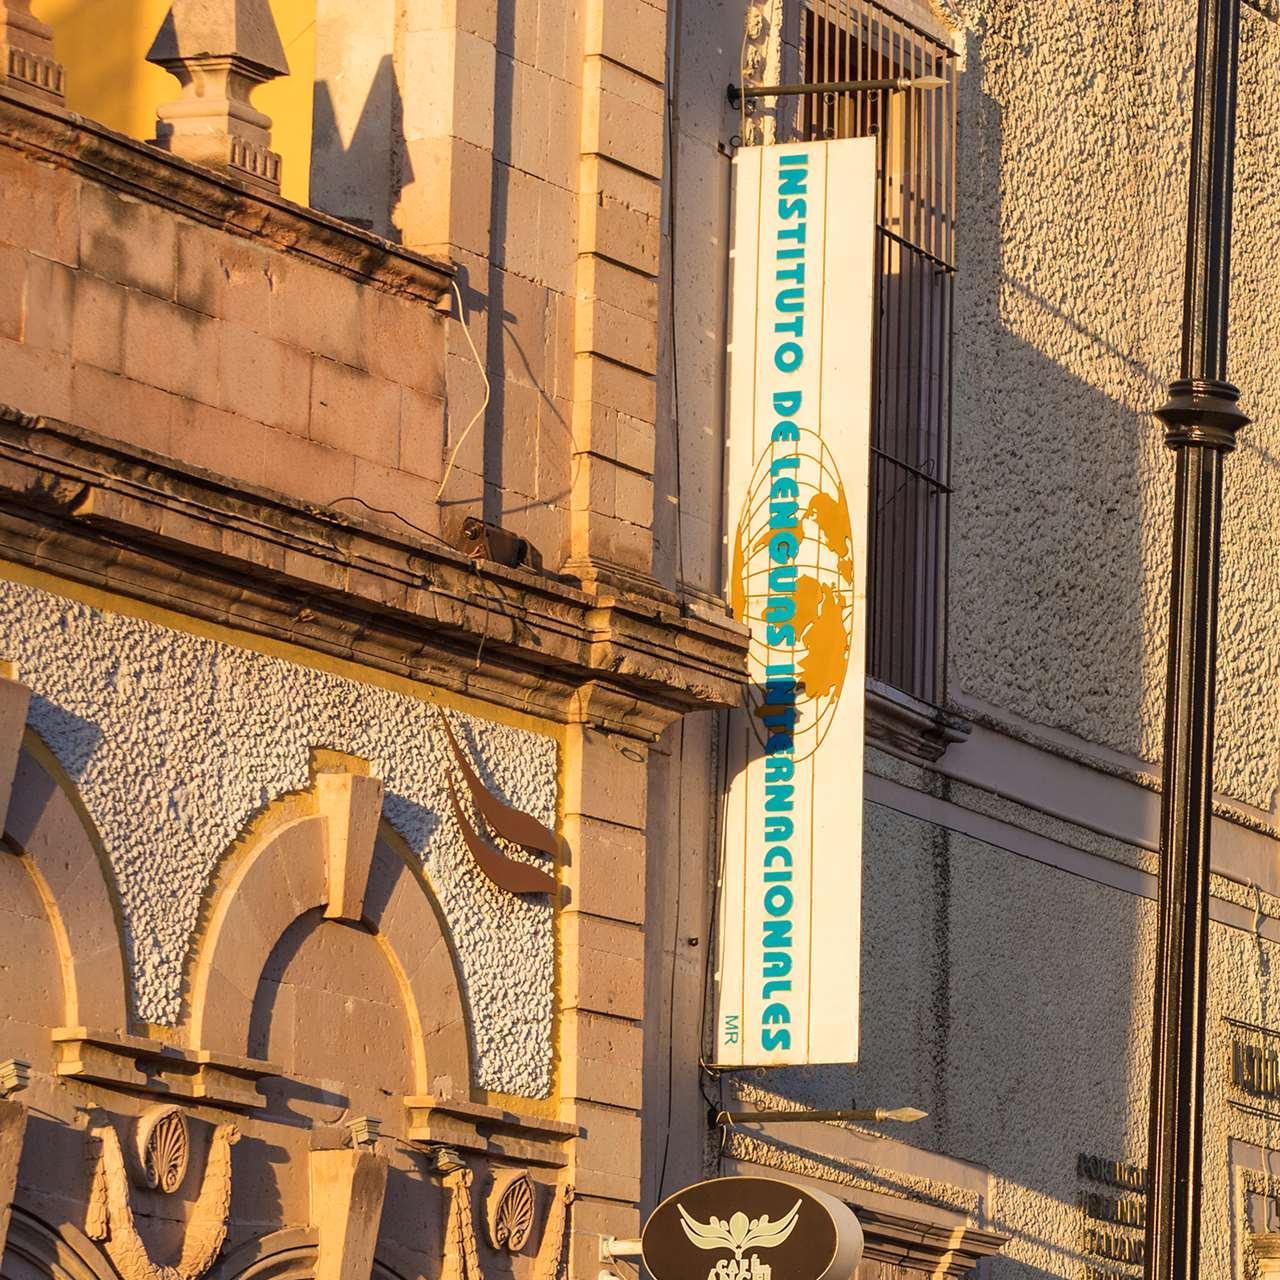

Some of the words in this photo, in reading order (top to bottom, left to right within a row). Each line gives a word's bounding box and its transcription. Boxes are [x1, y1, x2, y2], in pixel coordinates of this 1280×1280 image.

[773, 153, 809, 373] INSTITUTO
[771, 390, 803, 442] DE
[765, 457, 802, 648] LENGUAS
[760, 662, 797, 1055] INTERNACIONALES
[723, 1014, 739, 1046] MR
[716, 1254, 760, 1274] CAFÉ
